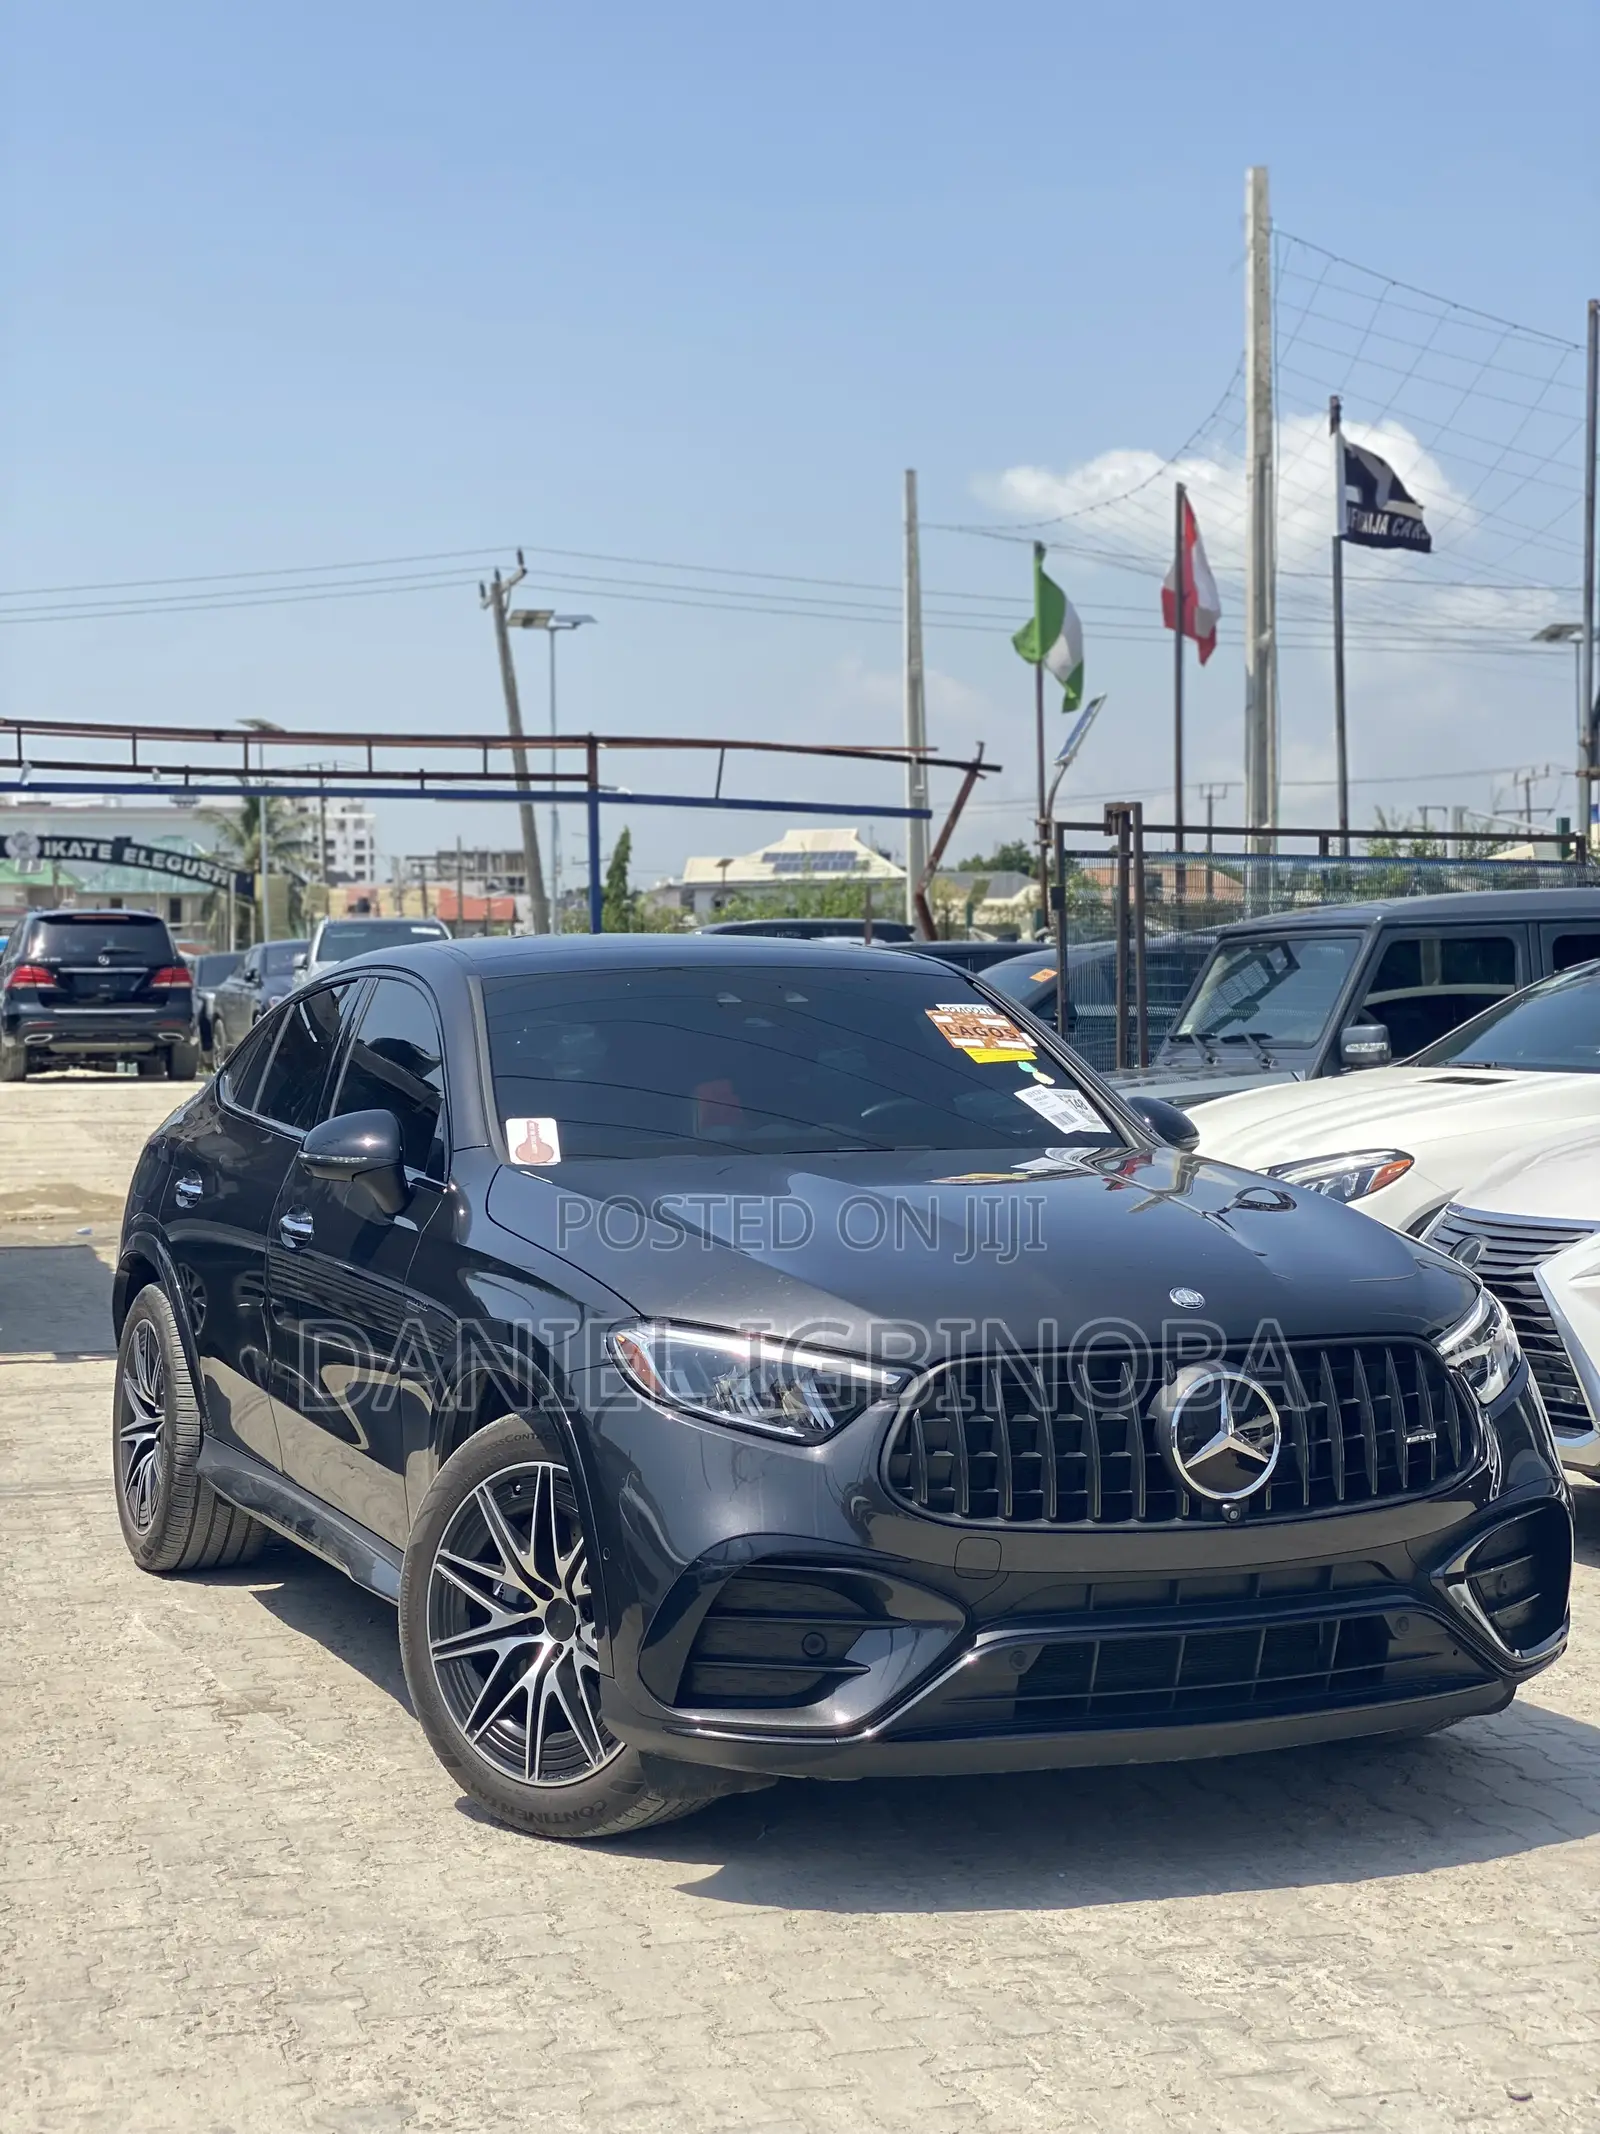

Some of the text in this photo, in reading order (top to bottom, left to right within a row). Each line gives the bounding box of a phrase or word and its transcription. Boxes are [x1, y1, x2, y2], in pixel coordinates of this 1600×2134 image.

[43, 840, 229, 886] IKATE ELEGUSH
[943, 1024, 1018, 1040] LAGOS
